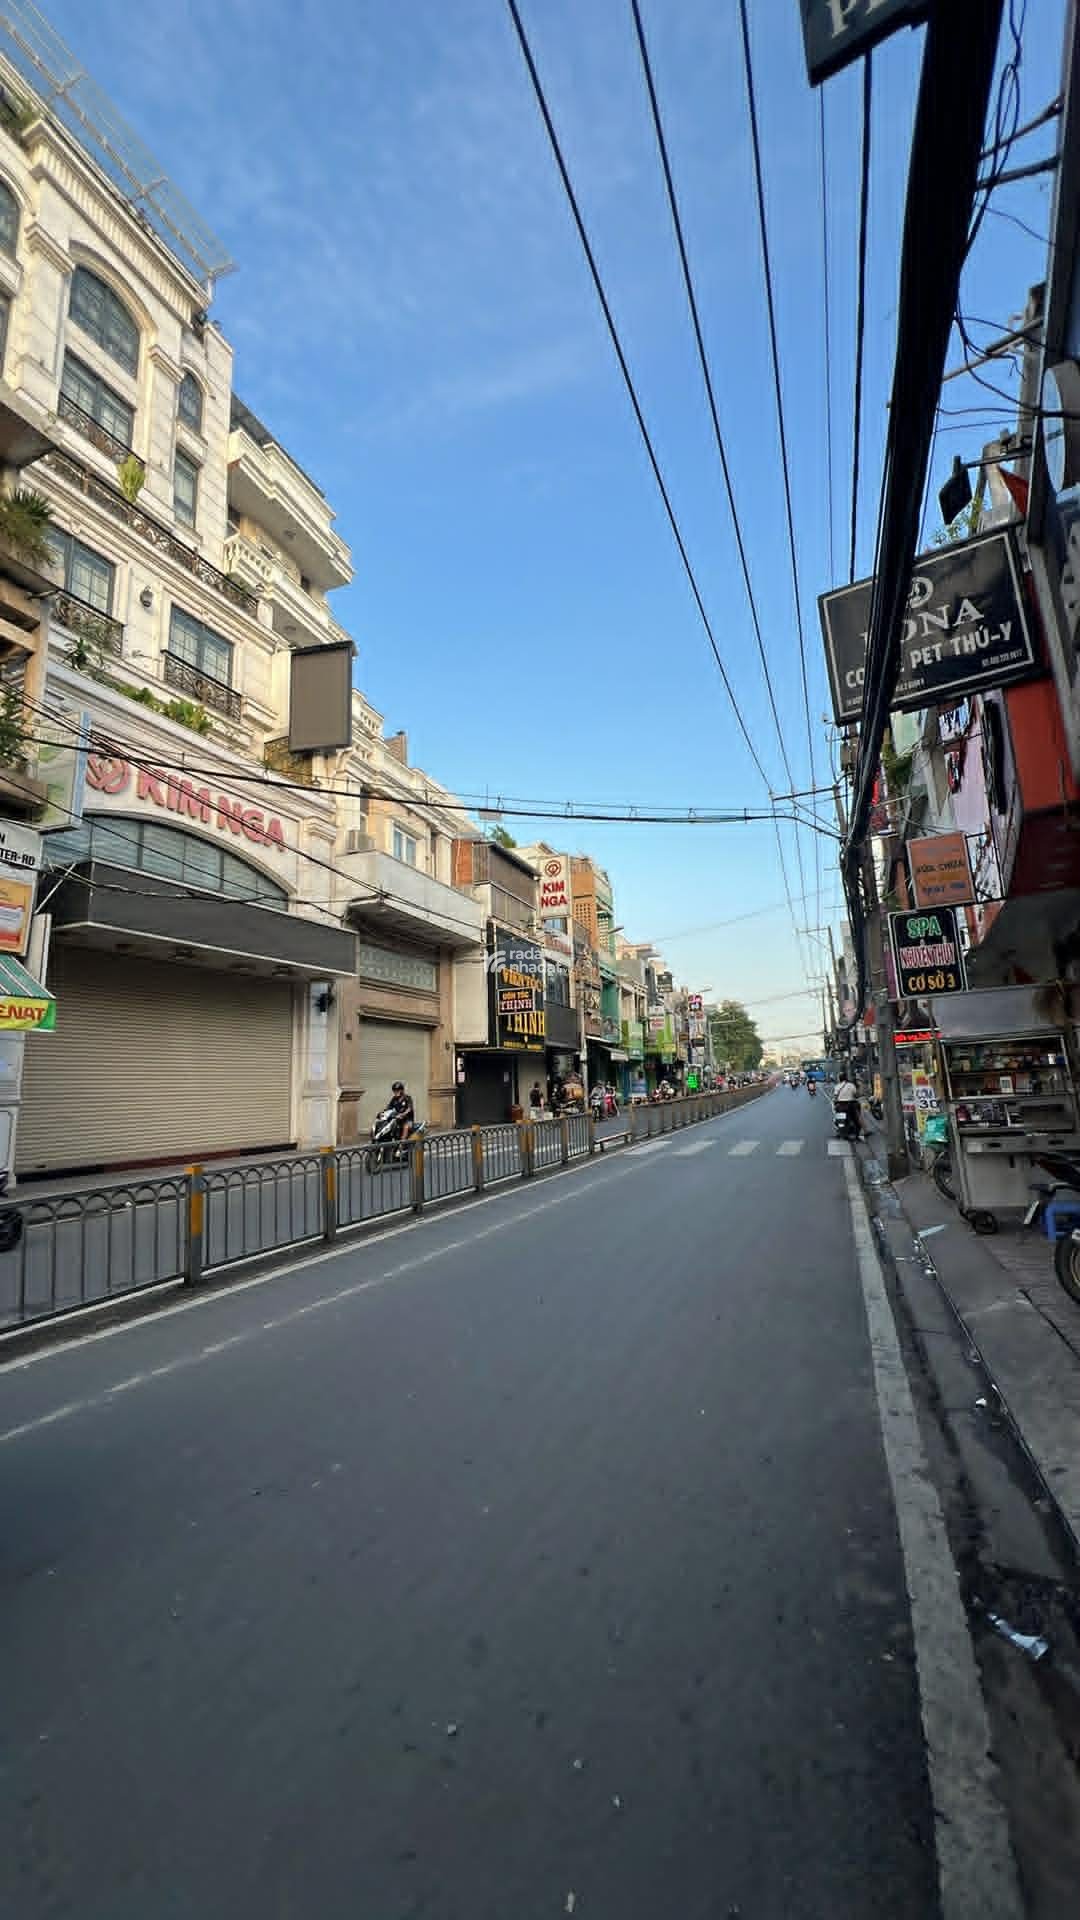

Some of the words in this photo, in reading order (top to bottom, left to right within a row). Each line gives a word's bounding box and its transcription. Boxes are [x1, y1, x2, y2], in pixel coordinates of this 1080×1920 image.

[910, 643, 943, 668] PET
[136, 767, 211, 824] KIM
[216, 795, 286, 852] NGA
[543, 880, 565, 894] KIM
[541, 896, 568, 908] NGA
[907, 916, 942, 939] SPA
